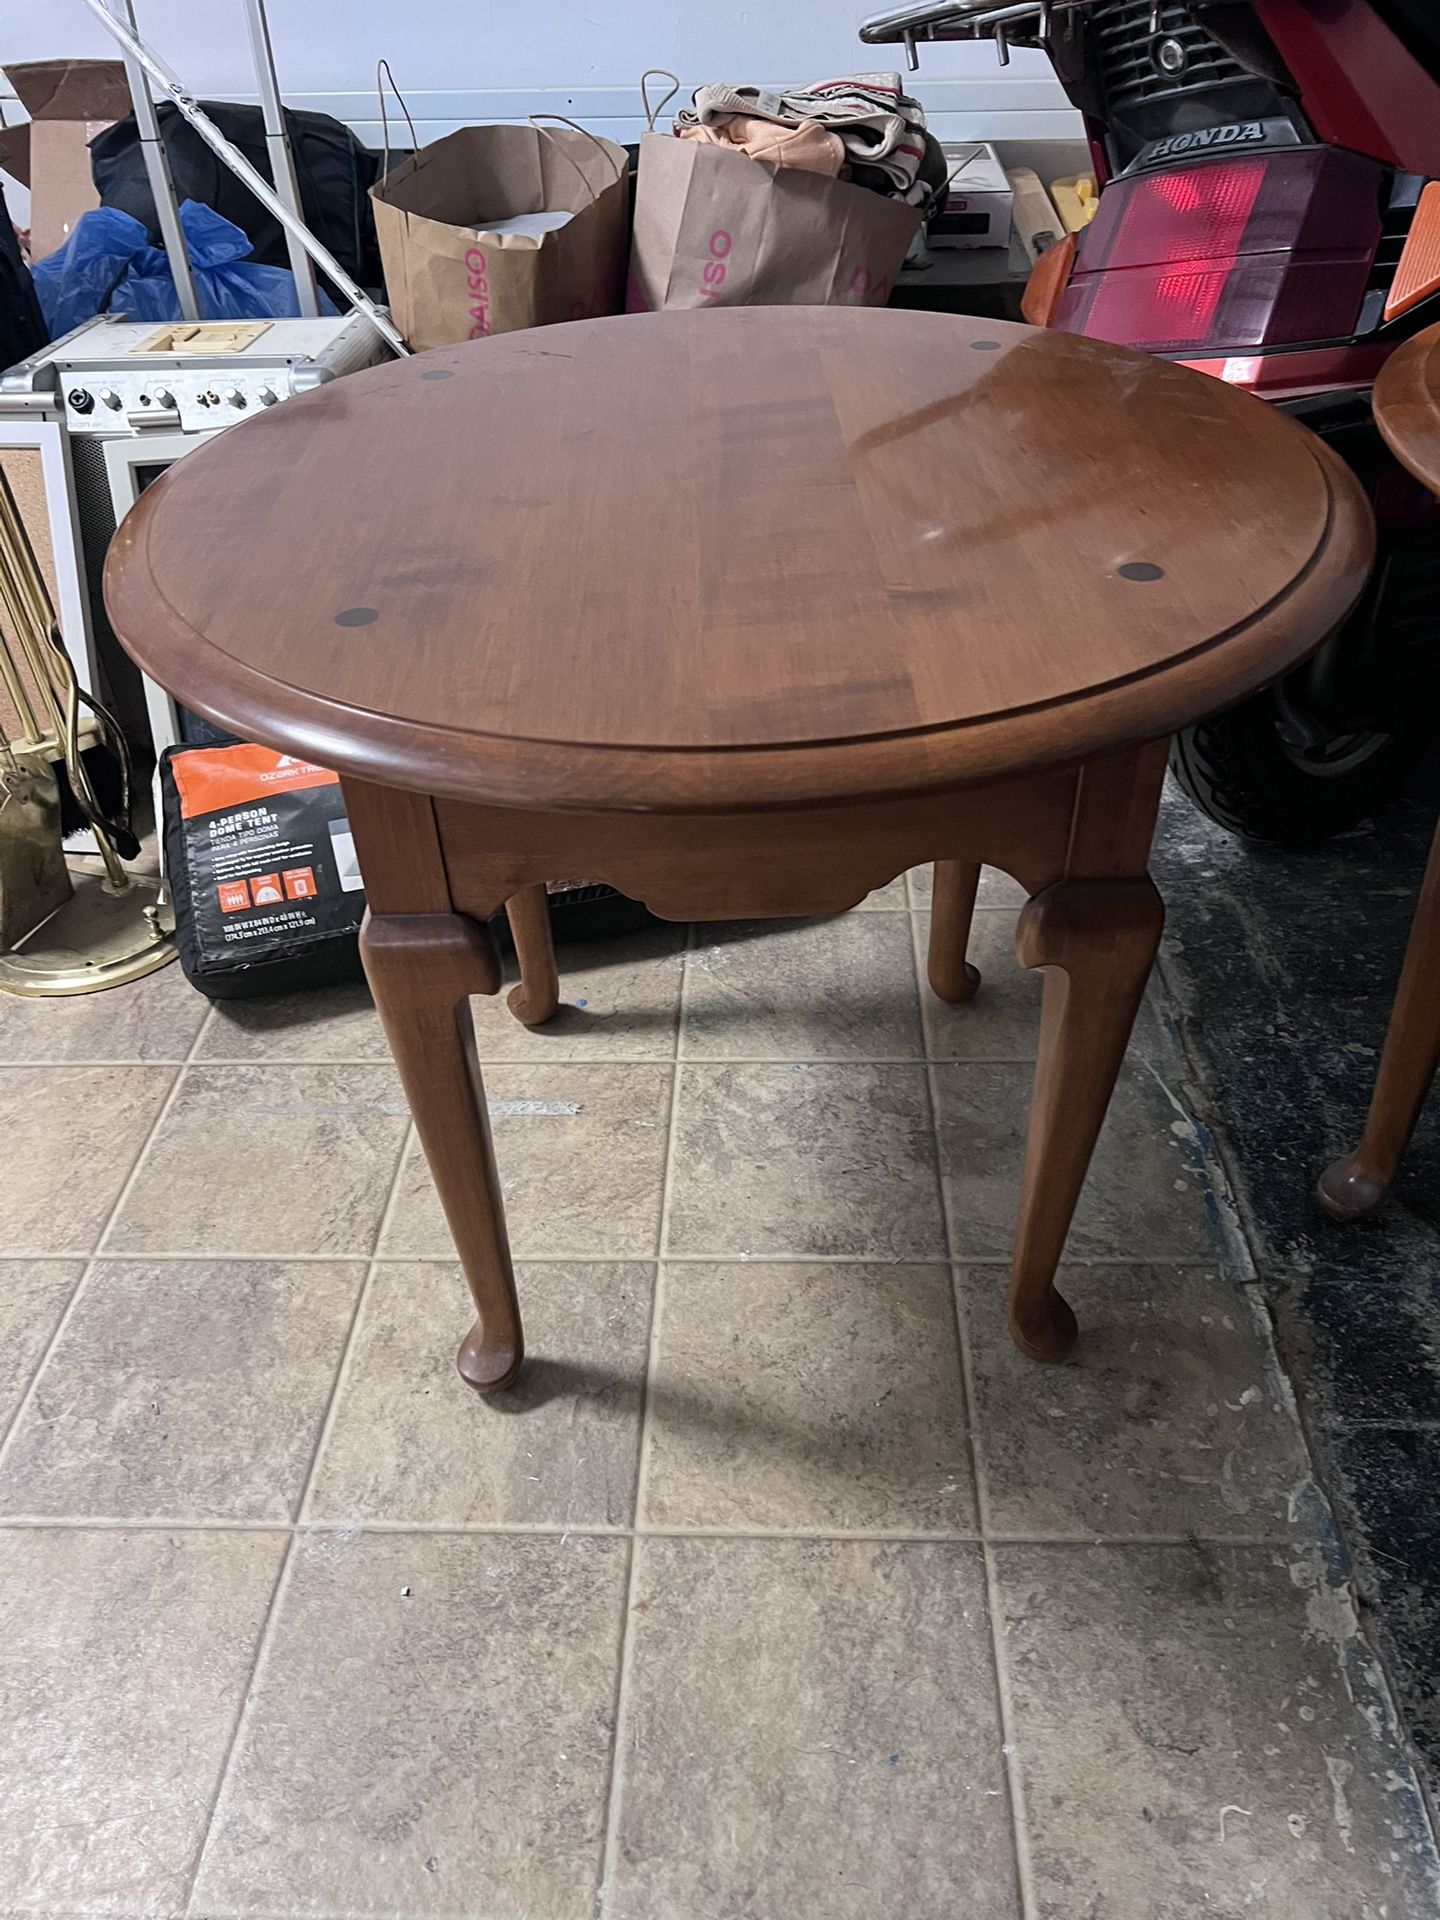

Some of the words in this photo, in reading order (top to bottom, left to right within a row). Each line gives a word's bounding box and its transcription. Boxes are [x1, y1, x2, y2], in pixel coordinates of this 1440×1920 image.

[1150, 122, 1265, 158] HONDA
[700, 229, 733, 307] ISO
[208, 807, 268, 829] 4-PERSON
[209, 822, 243, 838] DOME
[246, 813, 279, 828] TENT
[210, 834, 237, 846] TIENDA
[238, 829, 256, 839] TIPO
[211, 843, 231, 852] PARA
[239, 830, 279, 846] PERSONAS
